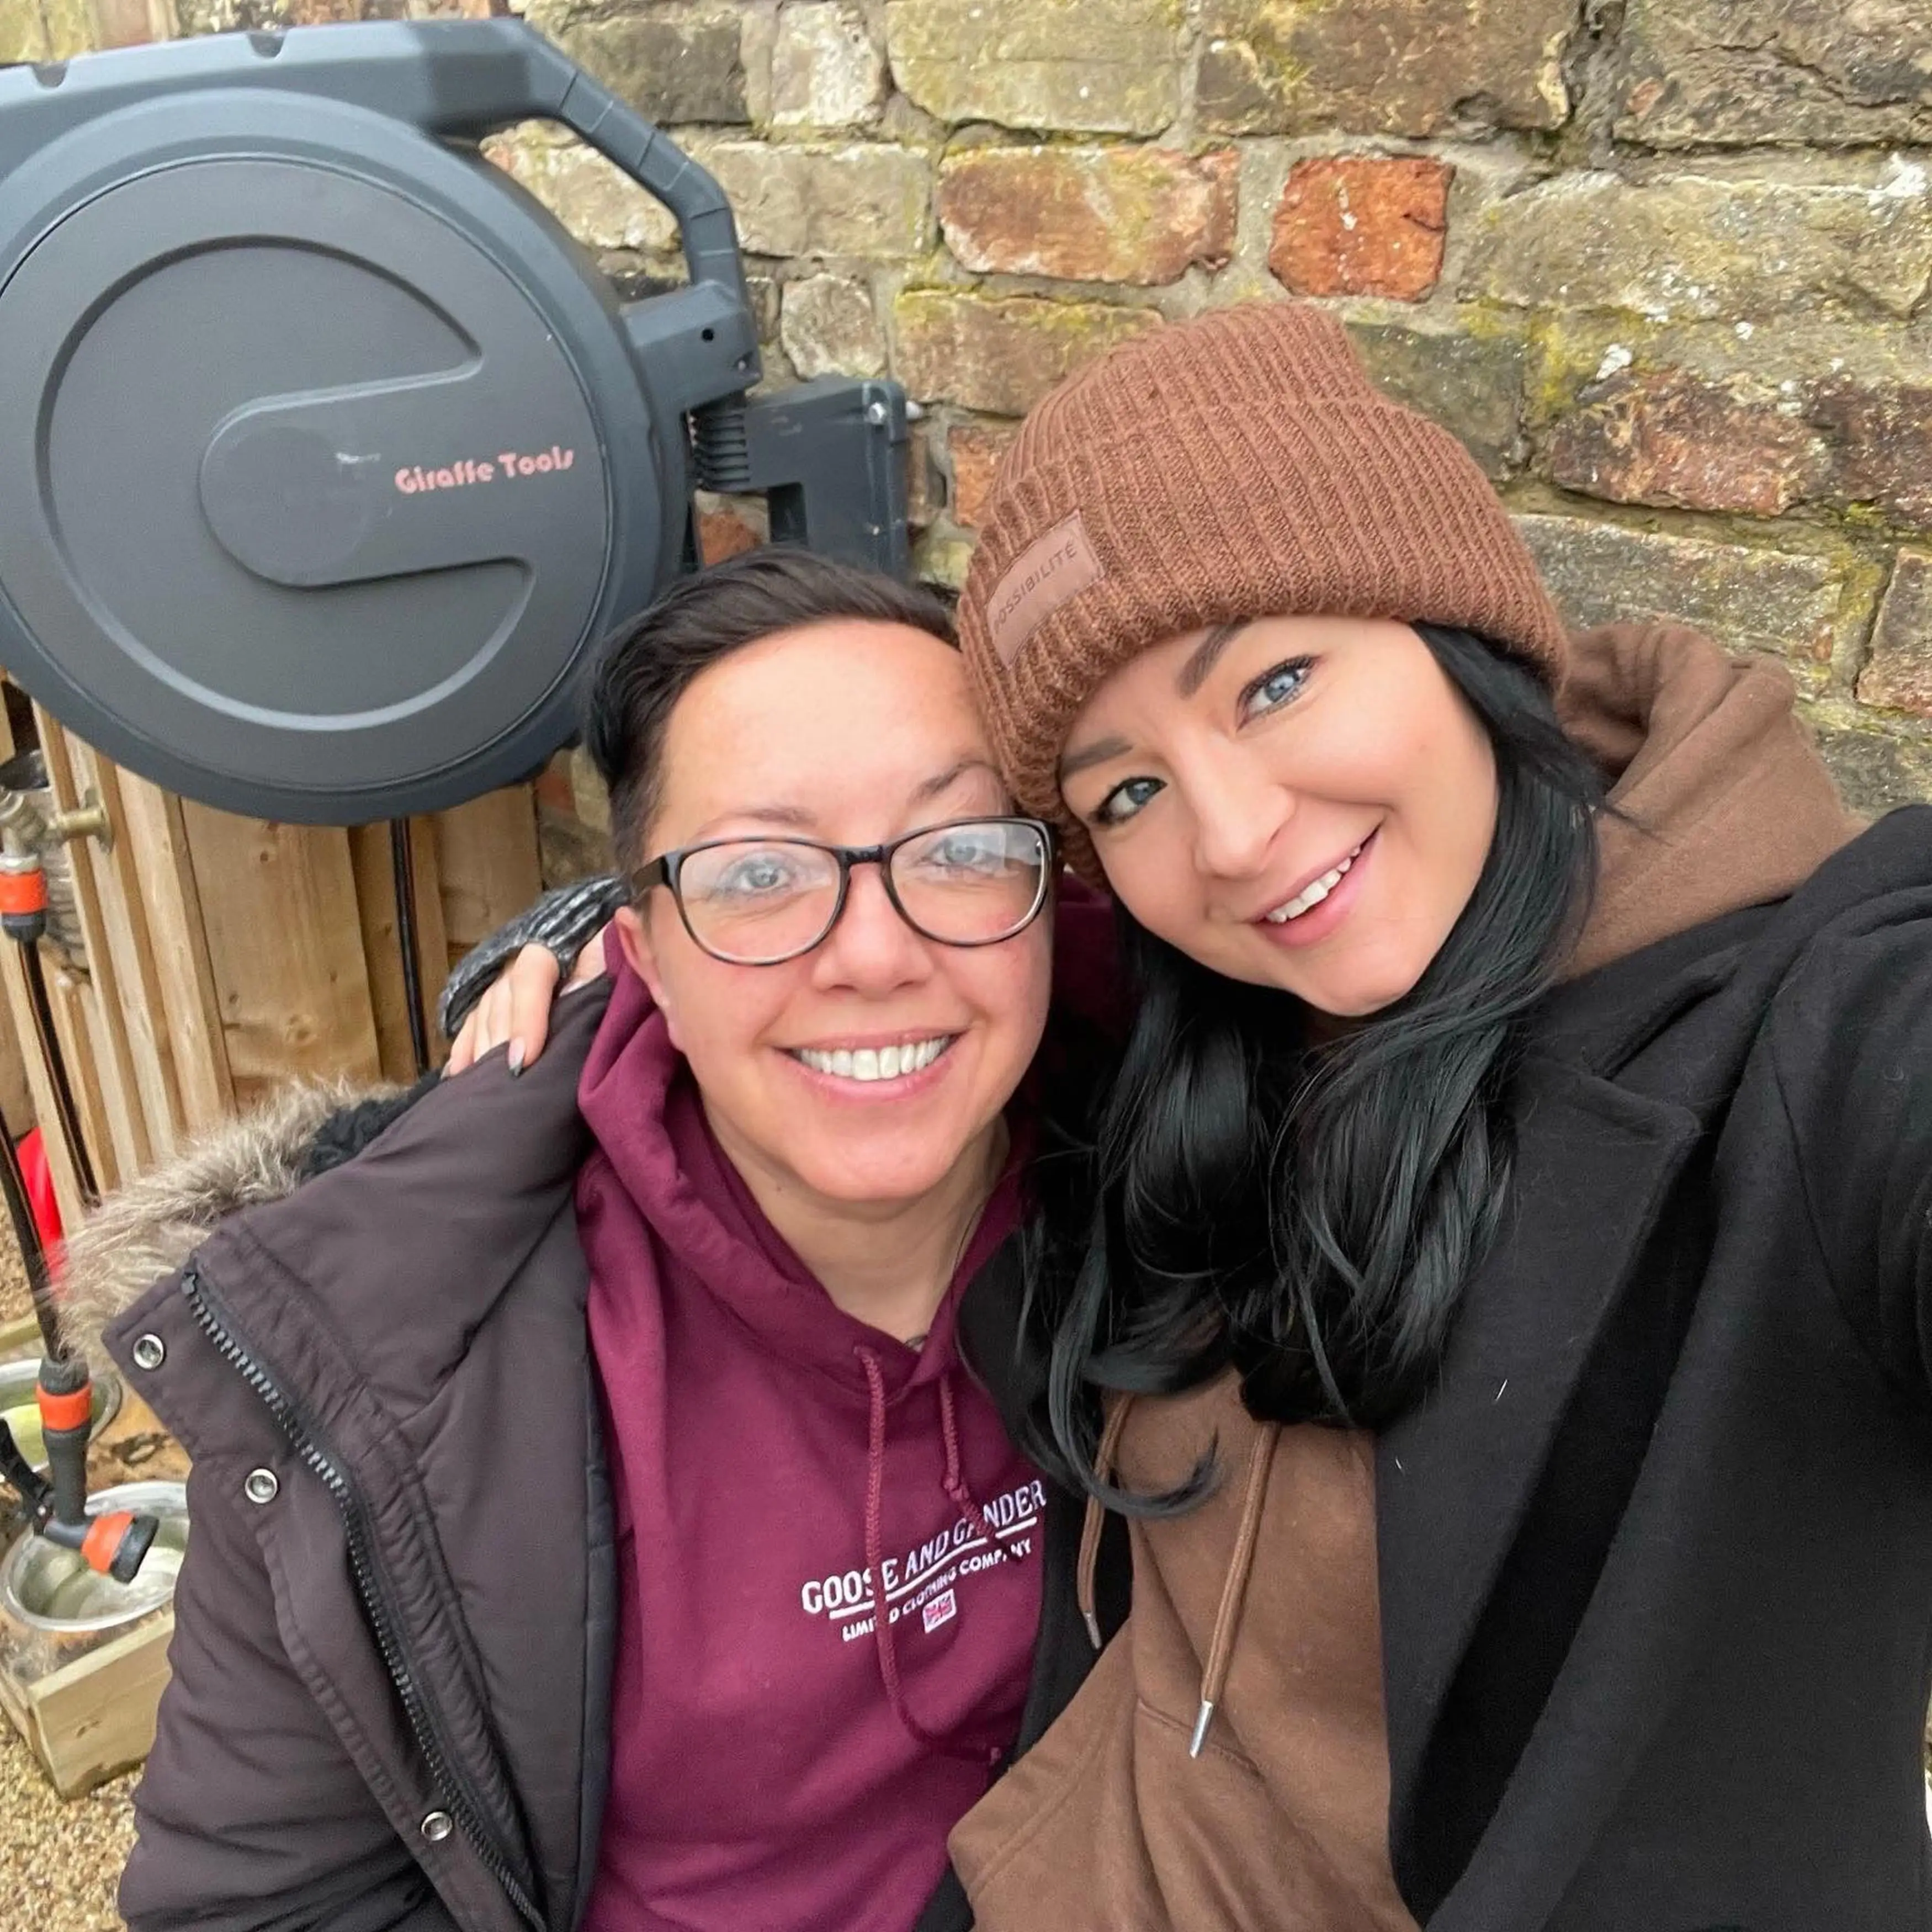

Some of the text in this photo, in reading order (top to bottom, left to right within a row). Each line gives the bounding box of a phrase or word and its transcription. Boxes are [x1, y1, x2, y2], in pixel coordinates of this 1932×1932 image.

[842, 1538, 1032, 1642] LIMID CLOTHING COMPNY
[905, 1531, 949, 1580] AND
